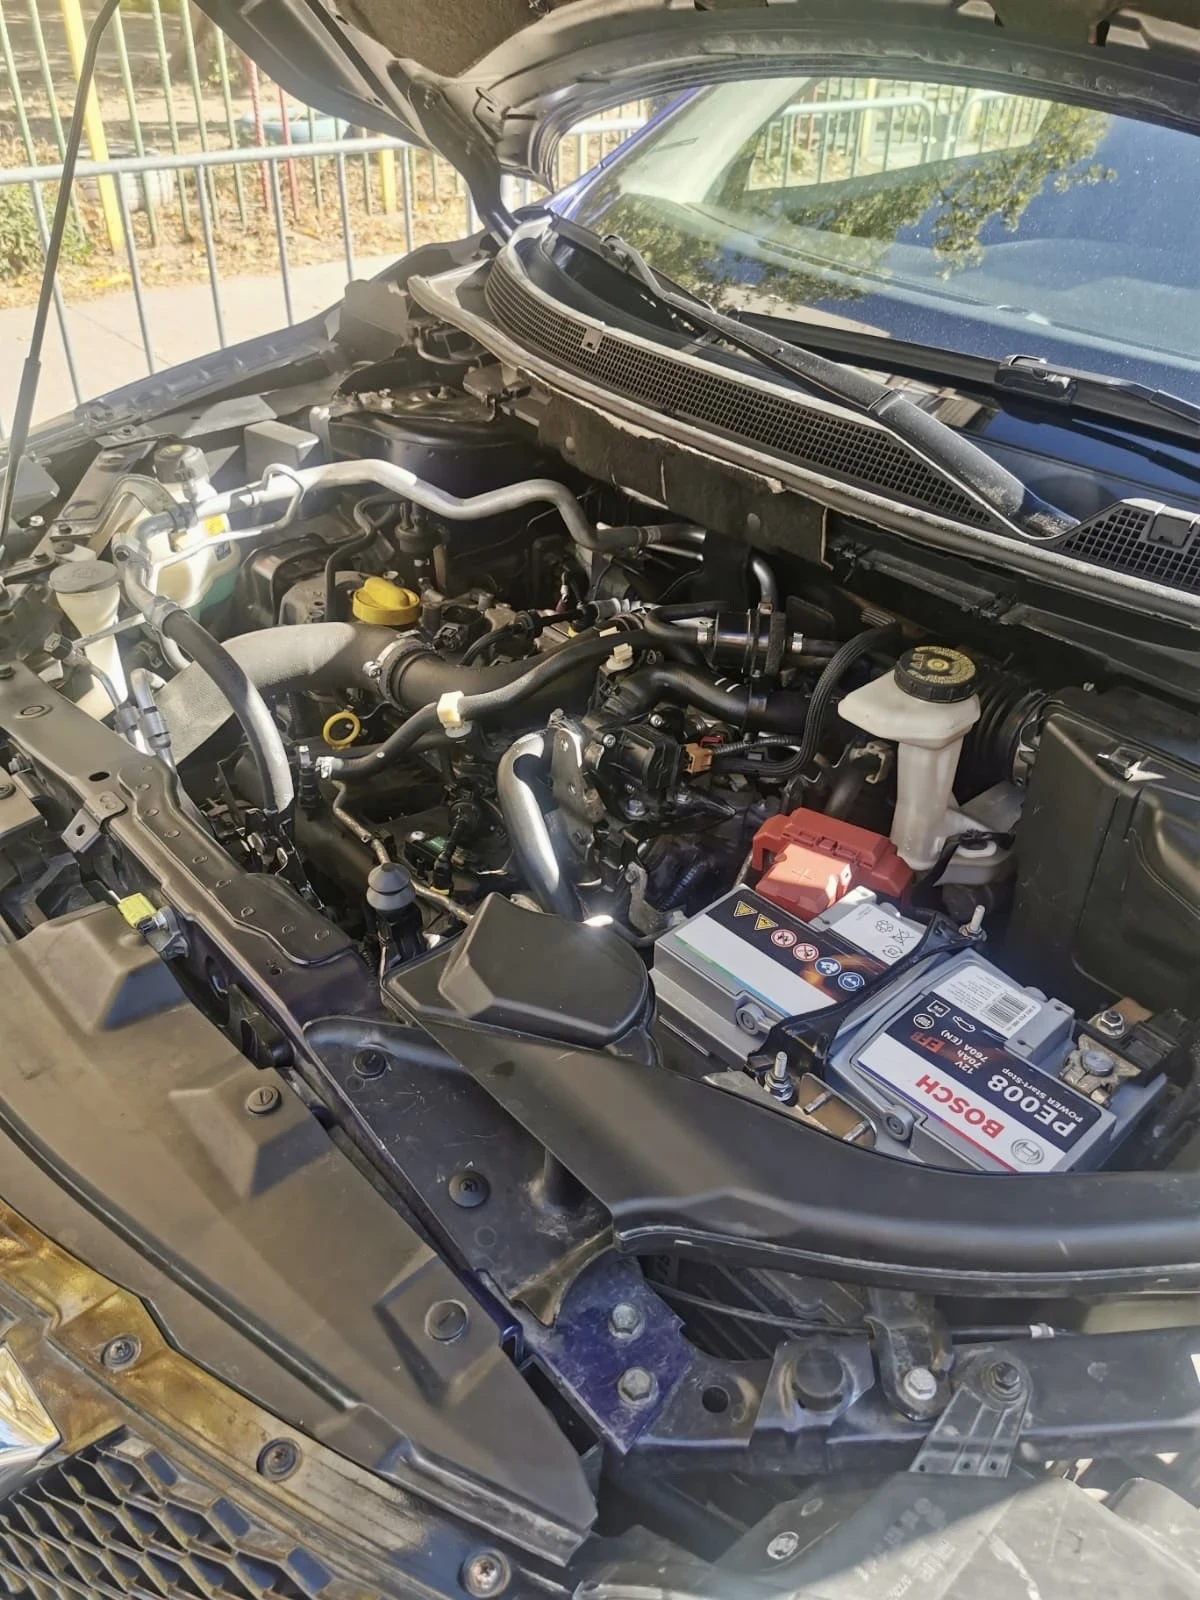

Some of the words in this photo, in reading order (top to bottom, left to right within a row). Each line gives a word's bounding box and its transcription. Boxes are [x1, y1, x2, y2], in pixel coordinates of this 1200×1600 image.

[941, 1029, 963, 1046] (EN)
[957, 1050, 982, 1069] 70Ah
[964, 1044, 988, 1063] 760A
[954, 1061, 974, 1075] 12V
[1002, 1068, 1047, 1100] Start-Stop
[914, 1074, 1005, 1139] BOSCH
[987, 1074, 1077, 1137] PE008
[1047, 1097, 1084, 1124] POWER
